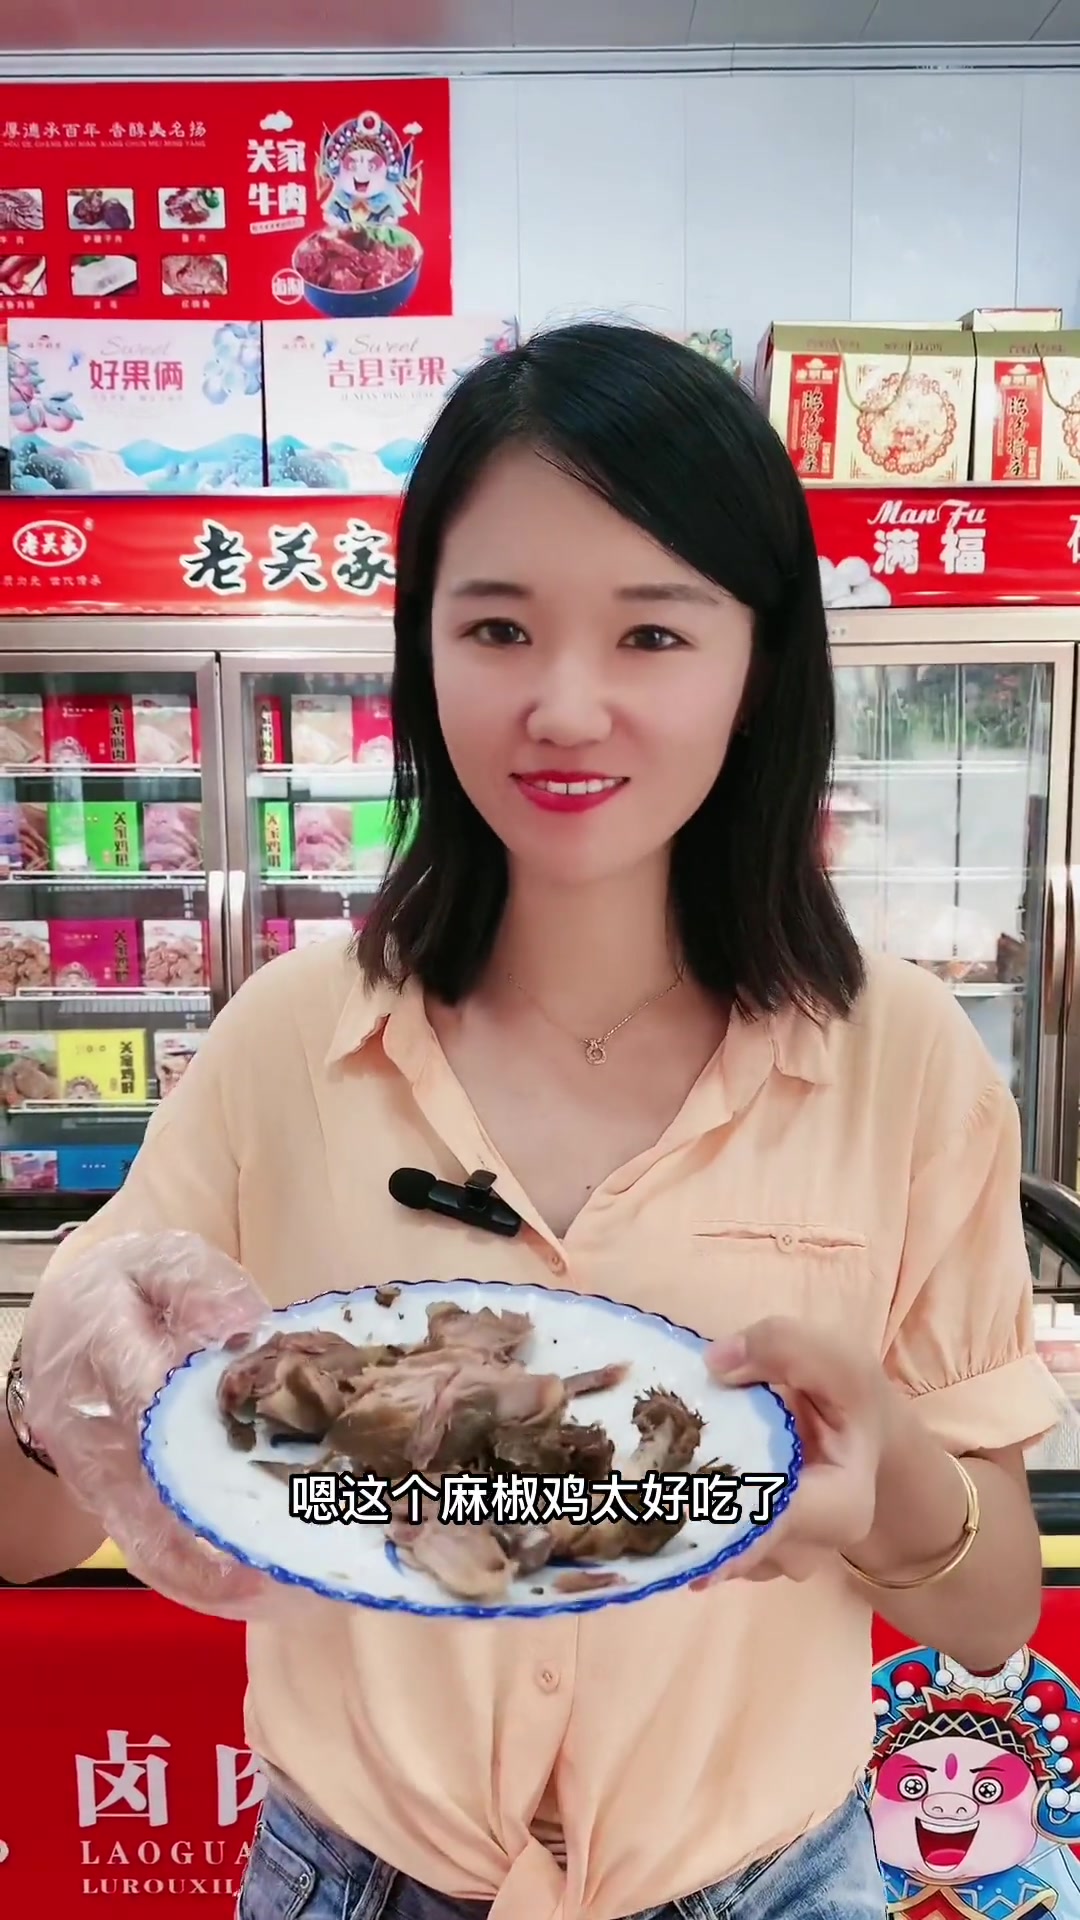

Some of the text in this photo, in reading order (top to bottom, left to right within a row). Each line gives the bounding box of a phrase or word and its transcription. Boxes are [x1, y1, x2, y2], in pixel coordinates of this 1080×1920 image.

[246, 138, 307, 173] 关家
[248, 181, 307, 216] 牛肉
[349, 335, 420, 355] Sweet
[89, 360, 184, 391] 好果俩
[328, 356, 448, 388] 吉县苹果
[867, 500, 936, 526] Man
[21, 530, 80, 557] 老关家
[179, 518, 397, 594] 老关家
[872, 529, 987, 575] 满福
